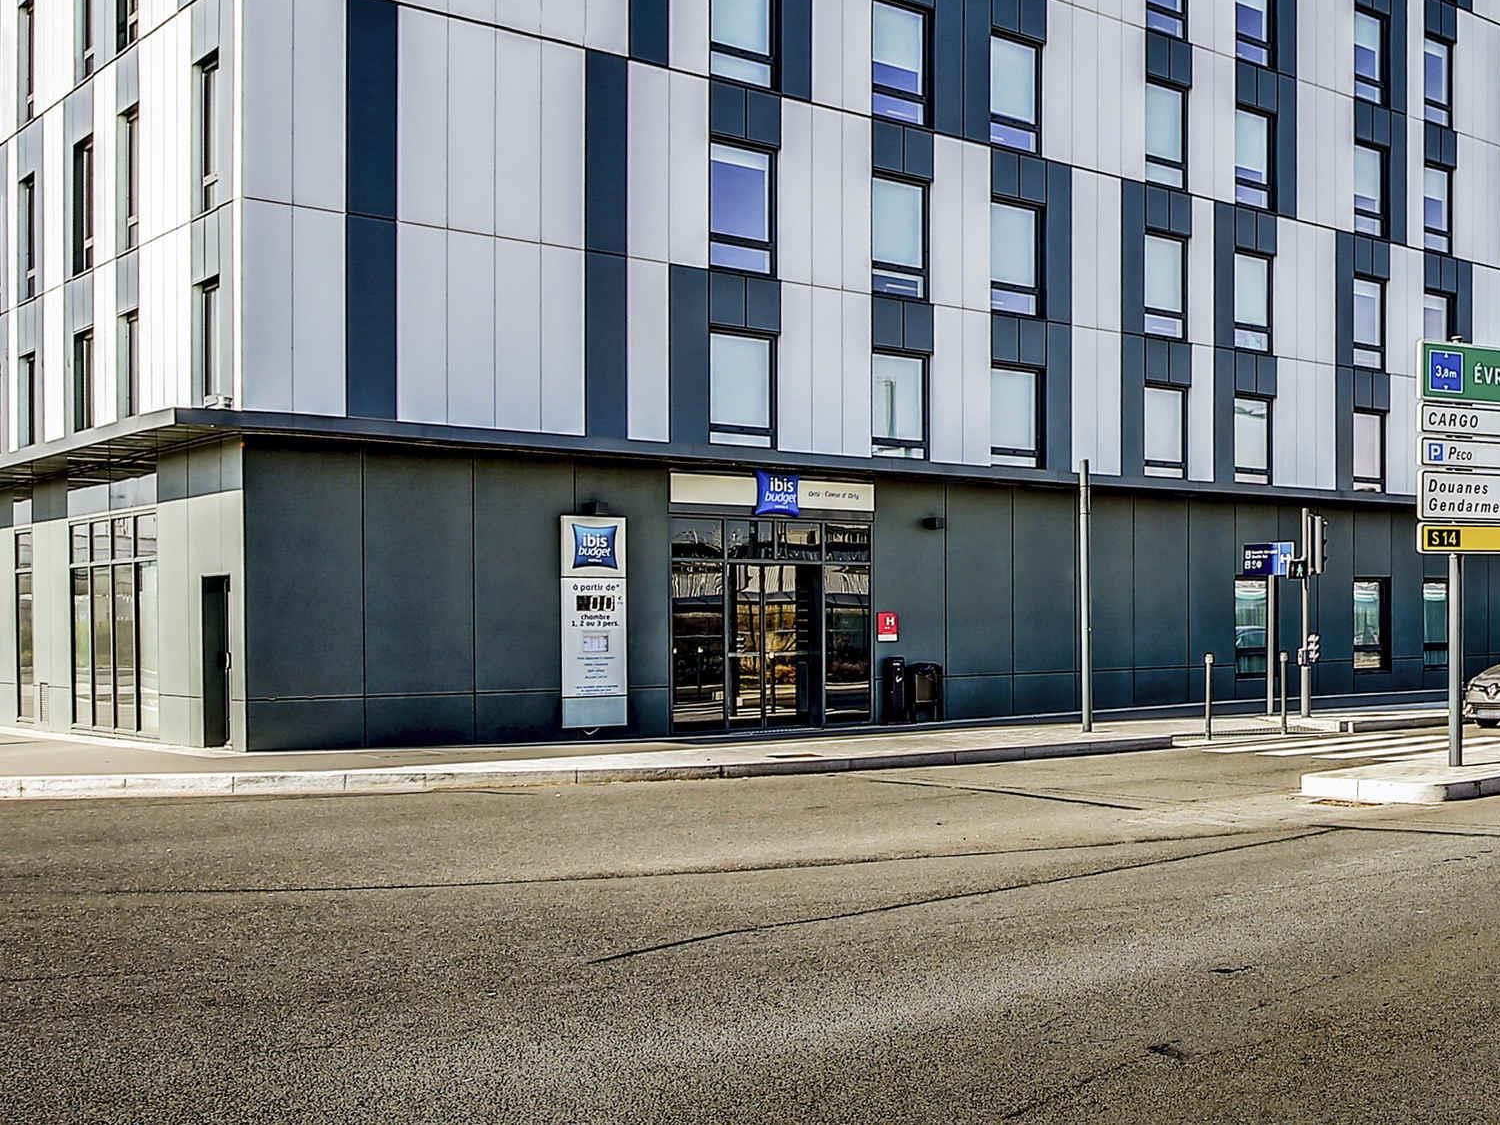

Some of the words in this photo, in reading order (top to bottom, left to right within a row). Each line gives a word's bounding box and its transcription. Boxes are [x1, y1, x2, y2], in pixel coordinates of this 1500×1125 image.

[1428, 411, 1479, 428] CARGO
[770, 477, 794, 492] ibis
[1428, 478, 1489, 495] Douanes
[764, 491, 797, 505] budget
[583, 533, 608, 548] ibis
[578, 546, 612, 559] budget
[580, 583, 604, 592] partir
[886, 616, 895, 626] H
